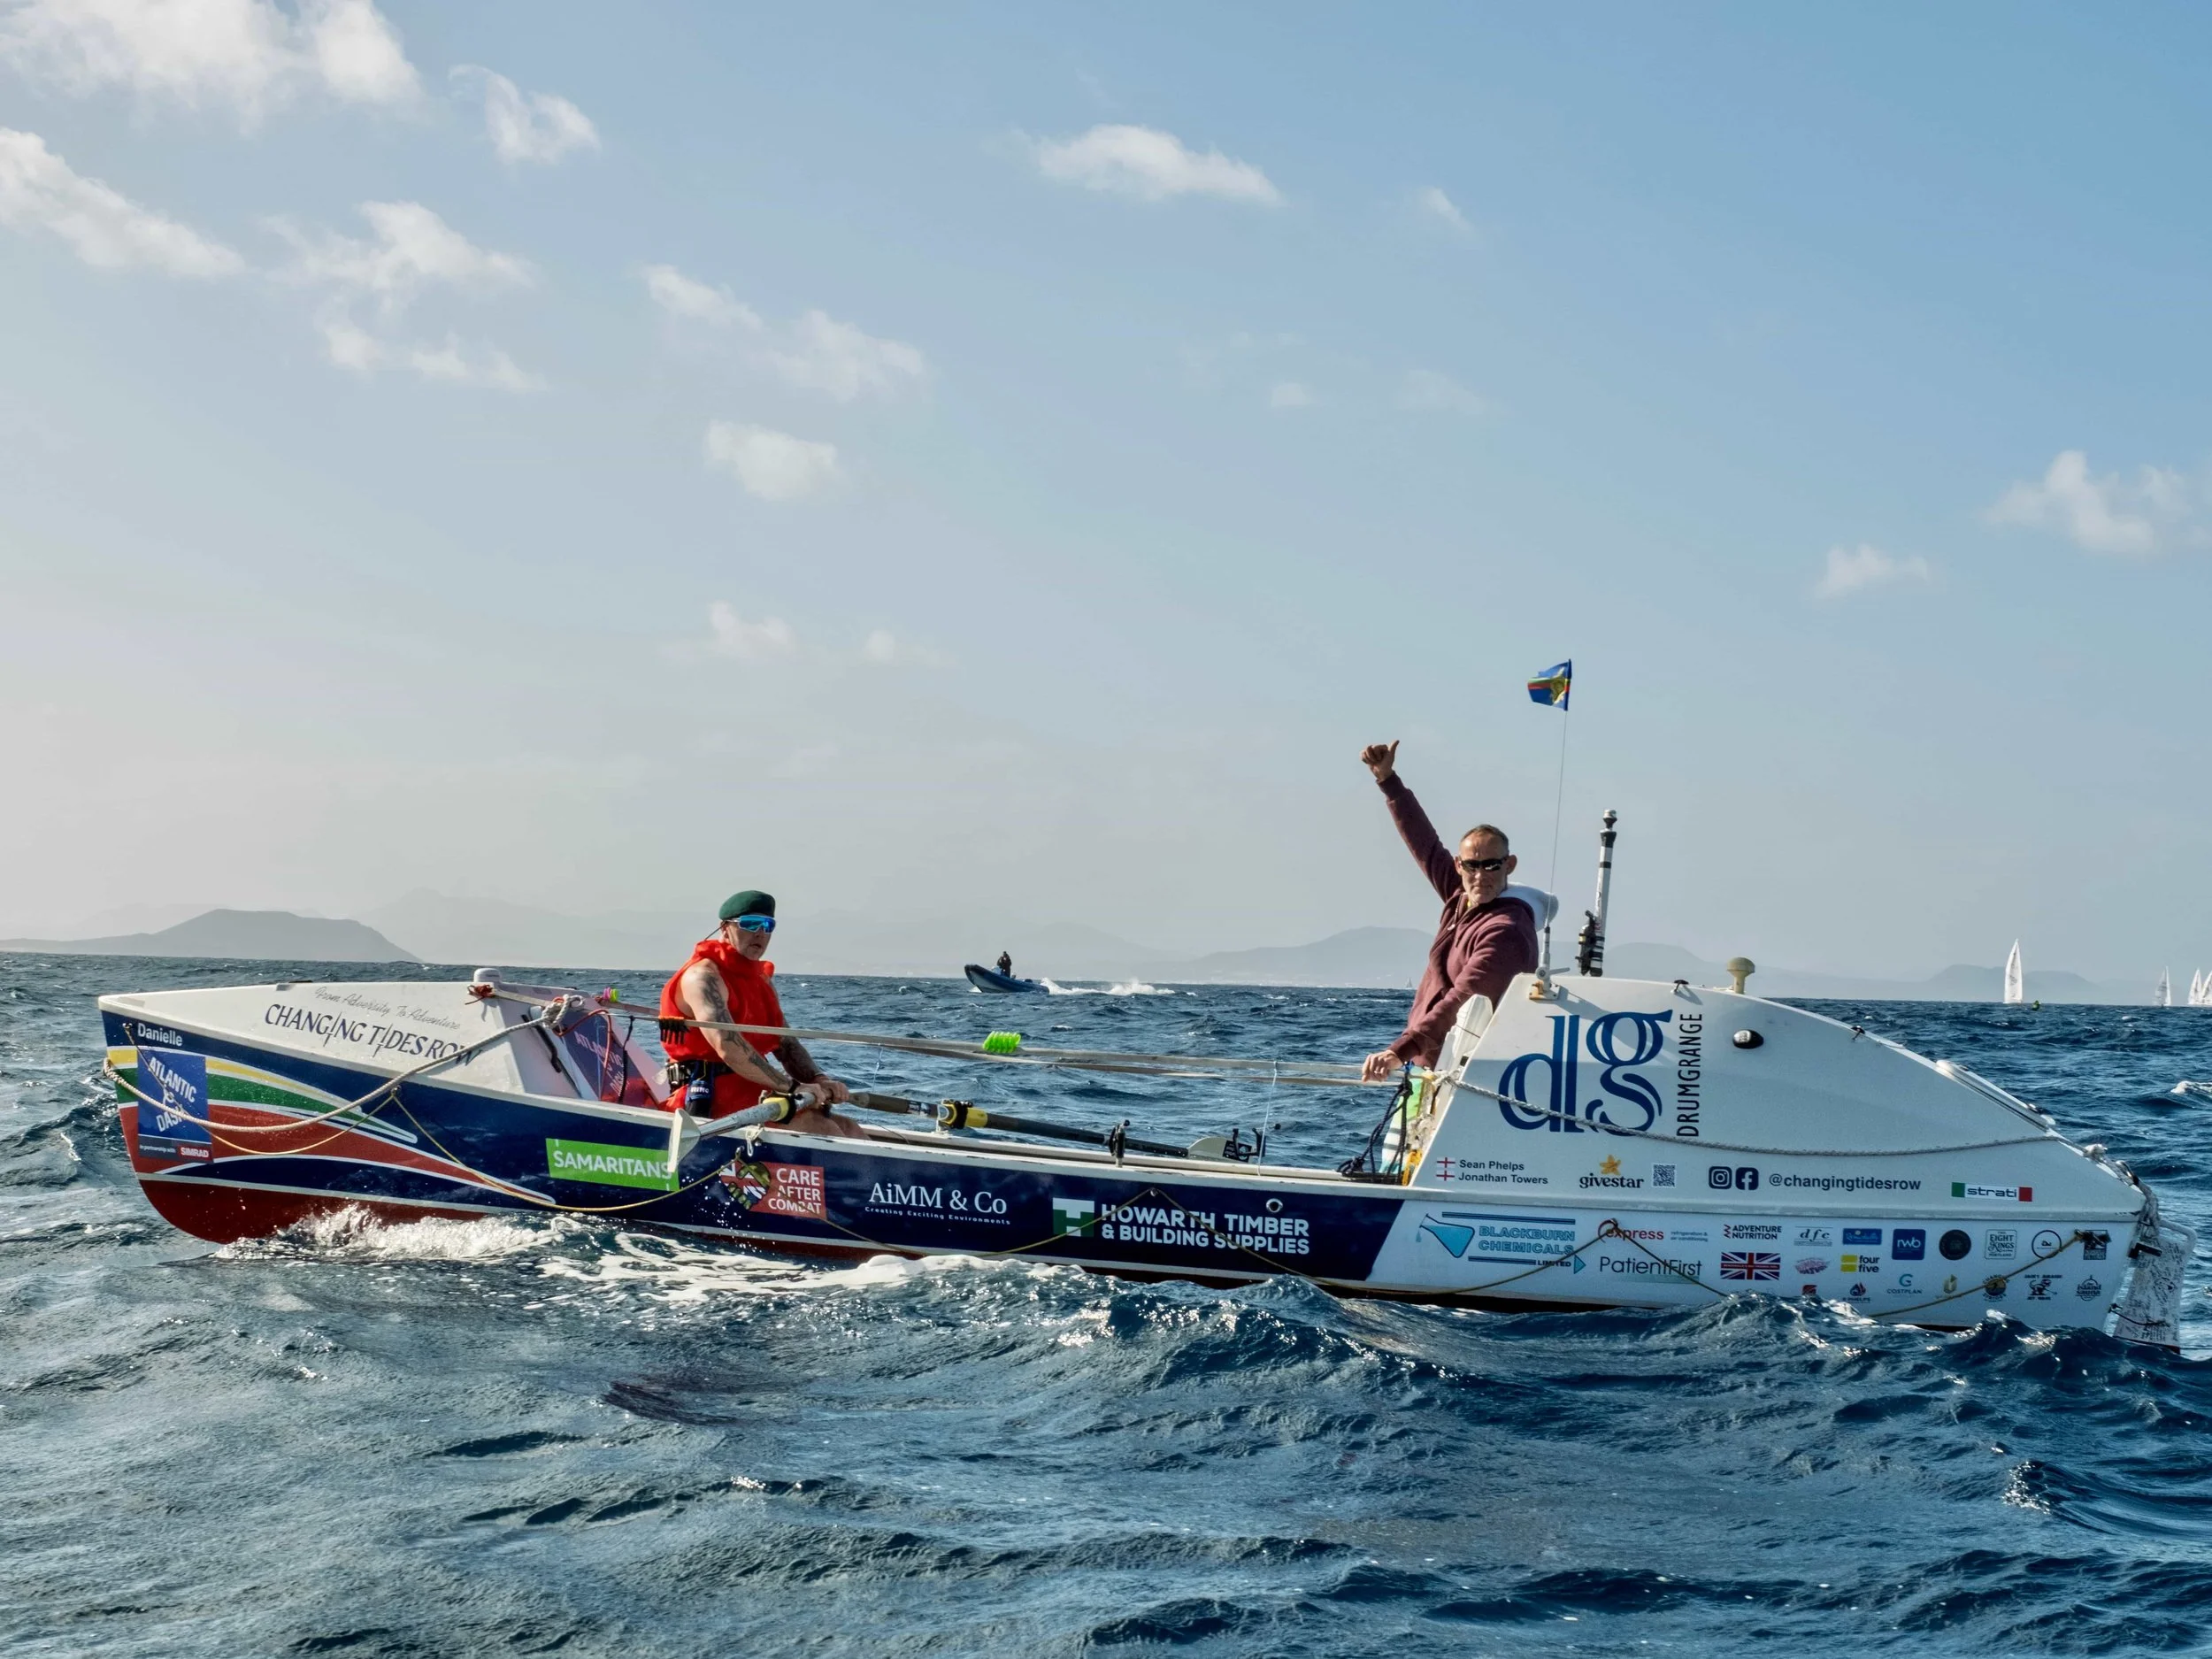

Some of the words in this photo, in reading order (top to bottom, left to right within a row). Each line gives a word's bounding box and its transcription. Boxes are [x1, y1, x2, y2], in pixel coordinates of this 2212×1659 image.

[315, 986, 339, 1002] From
[343, 994, 391, 1016] Adversity
[397, 1005, 408, 1017] To
[406, 1010, 460, 1030] Adventure
[137, 1023, 183, 1047] Danielle
[265, 1003, 366, 1047] CHANGING
[367, 1023, 428, 1057] TIDES
[148, 1056, 197, 1103] ATLANTIC
[1676, 1013, 1703, 1138] DRUMGRANGE
[180, 1147, 210, 1158] SIMRAD
[553, 1150, 672, 1179] SAMARITANS
[1459, 1159, 1486, 1170] Sean
[1488, 1161, 1525, 1171] Phelps
[776, 1168, 820, 1186] CARE
[1458, 1172, 1508, 1183] Jonathan
[1510, 1174, 1548, 1185] Towers
[1579, 1173, 1644, 1189] givestar
[1769, 1173, 1921, 1192] @changingtidesrow
[777, 1185, 821, 1202] AFTER
[868, 1182, 943, 1209] AiMM
[949, 1189, 969, 1211] &
[974, 1191, 1007, 1215] Co
[1967, 1187, 2017, 1198] strati
[768, 1198, 822, 1214] COMBAT
[864, 1206, 903, 1216] Creating
[907, 1210, 945, 1220] Exciting
[948, 1214, 1011, 1225] Environments
[1102, 1203, 1216, 1230] HOWARTH
[1224, 1213, 1310, 1237] TIMBER
[1102, 1223, 1115, 1240] &
[1119, 1225, 1209, 1248] BUILDING
[1214, 1233, 1310, 1255] SUPPLIES
[1479, 1225, 1575, 1241] BLACKBURN
[1478, 1240, 1575, 1256] CHEMICALS
[1600, 1256, 1703, 1276] PatientFirst
[1859, 1255, 1880, 1263] four
